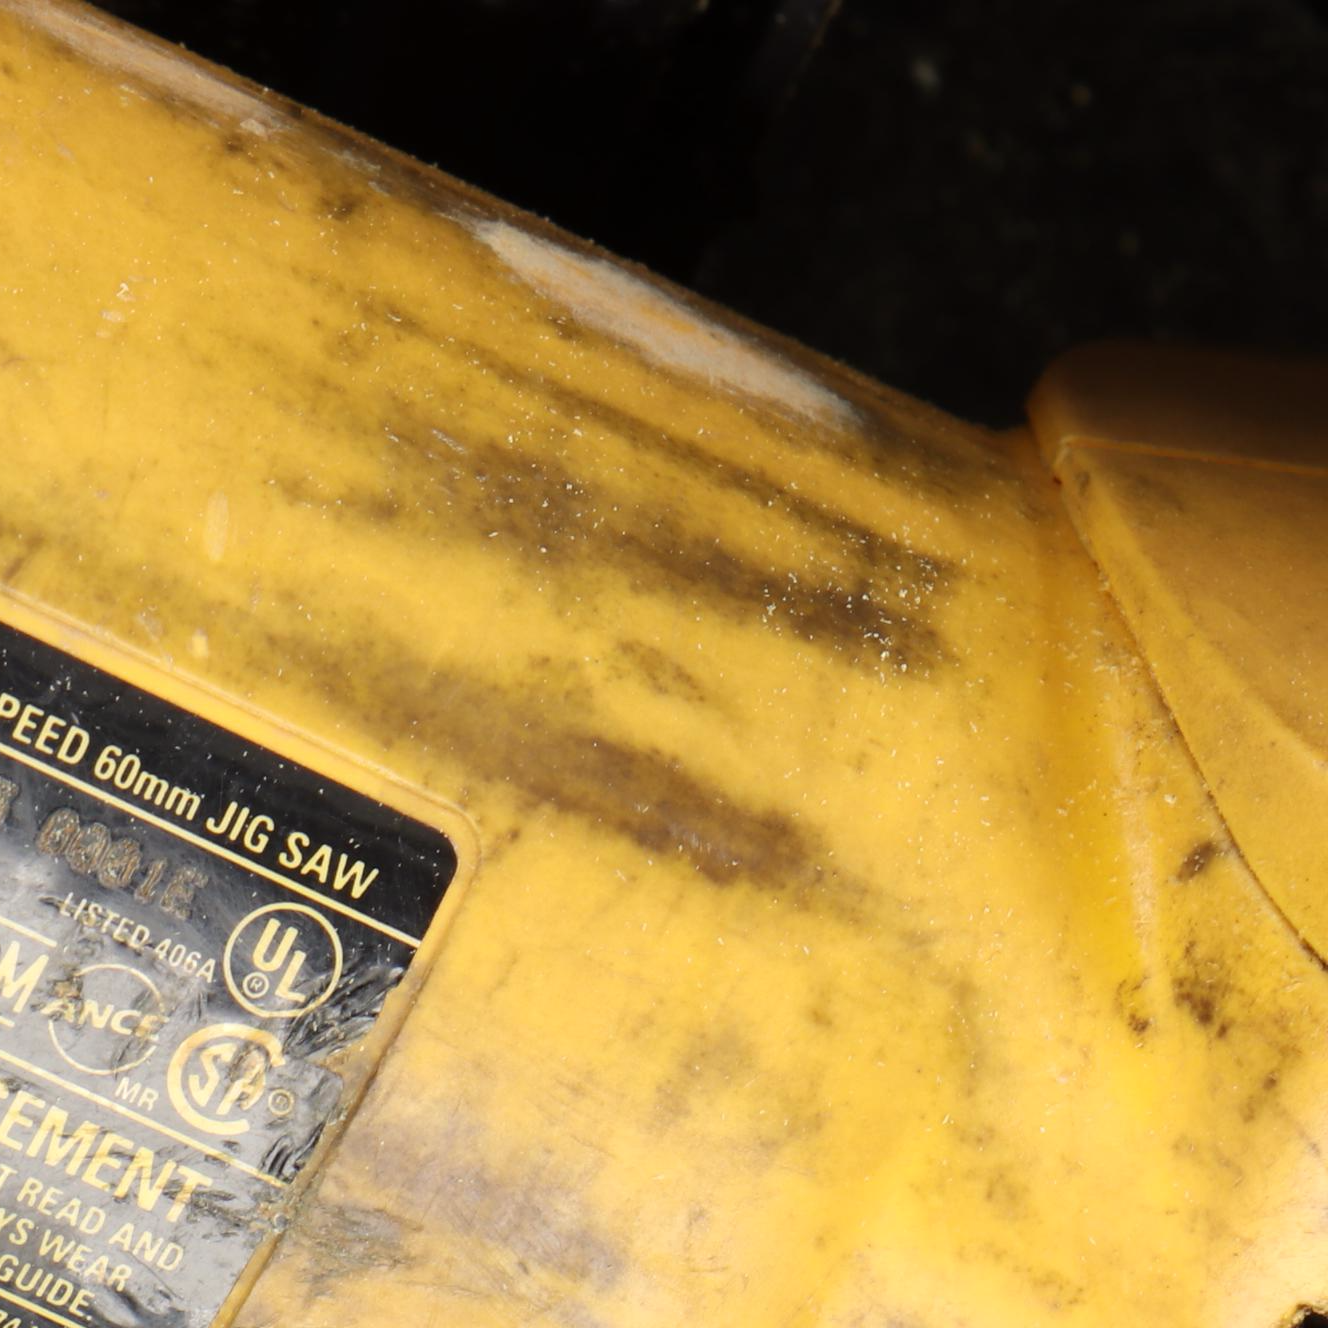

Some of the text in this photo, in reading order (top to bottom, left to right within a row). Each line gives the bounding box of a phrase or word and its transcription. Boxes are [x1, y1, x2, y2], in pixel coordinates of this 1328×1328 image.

[90, 743, 204, 822] 60mm
[204, 797, 275, 855] JIG
[275, 830, 377, 904] SAW
[60, 893, 217, 982] LISTED 406A
[40, 999, 170, 1042] ANCE
[115, 1077, 160, 1111] MR
[16, 1178, 106, 1235] READ
[108, 1221, 184, 1271] AND
[36, 1231, 133, 1290] WEAR
